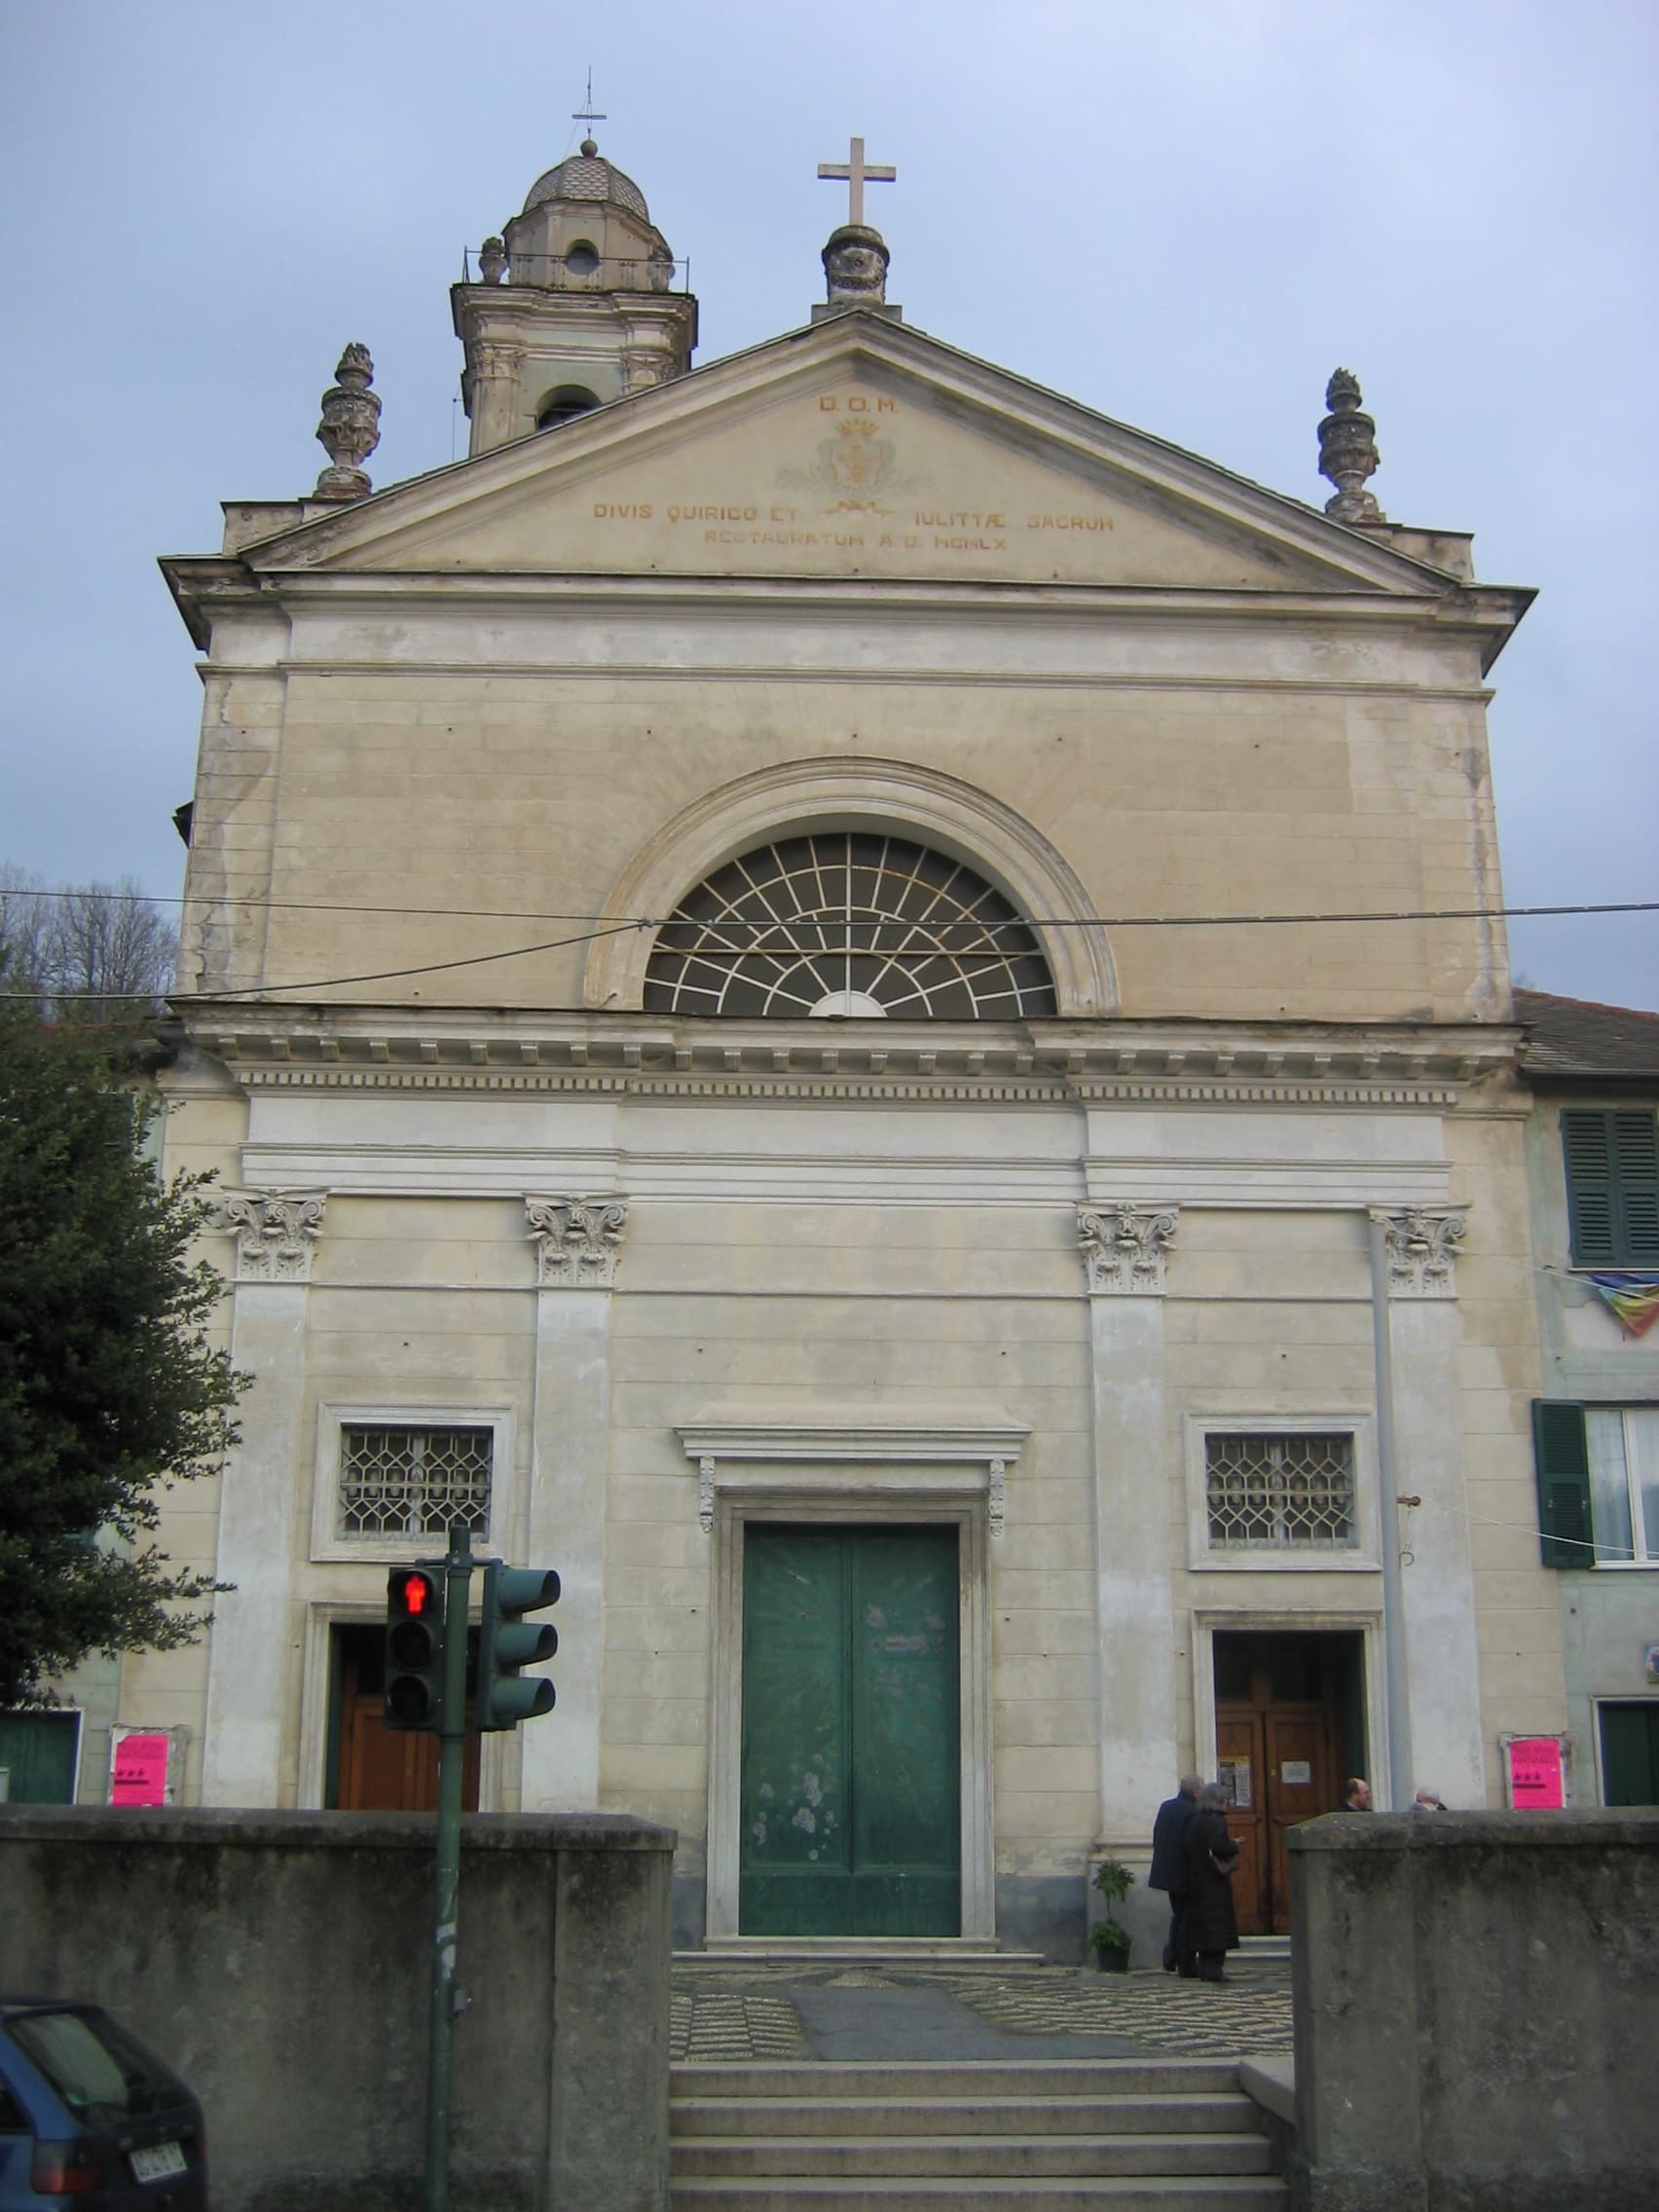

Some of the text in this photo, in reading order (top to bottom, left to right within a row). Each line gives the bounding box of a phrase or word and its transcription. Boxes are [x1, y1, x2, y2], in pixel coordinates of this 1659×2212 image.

[593, 502, 653, 520] DIVIS
[667, 504, 758, 524] QUIRICO
[769, 505, 798, 523] ET
[1026, 513, 1115, 532] SACRUM
[704, 529, 865, 546] RESTAURATUM
[934, 535, 1008, 551] MCMLX
